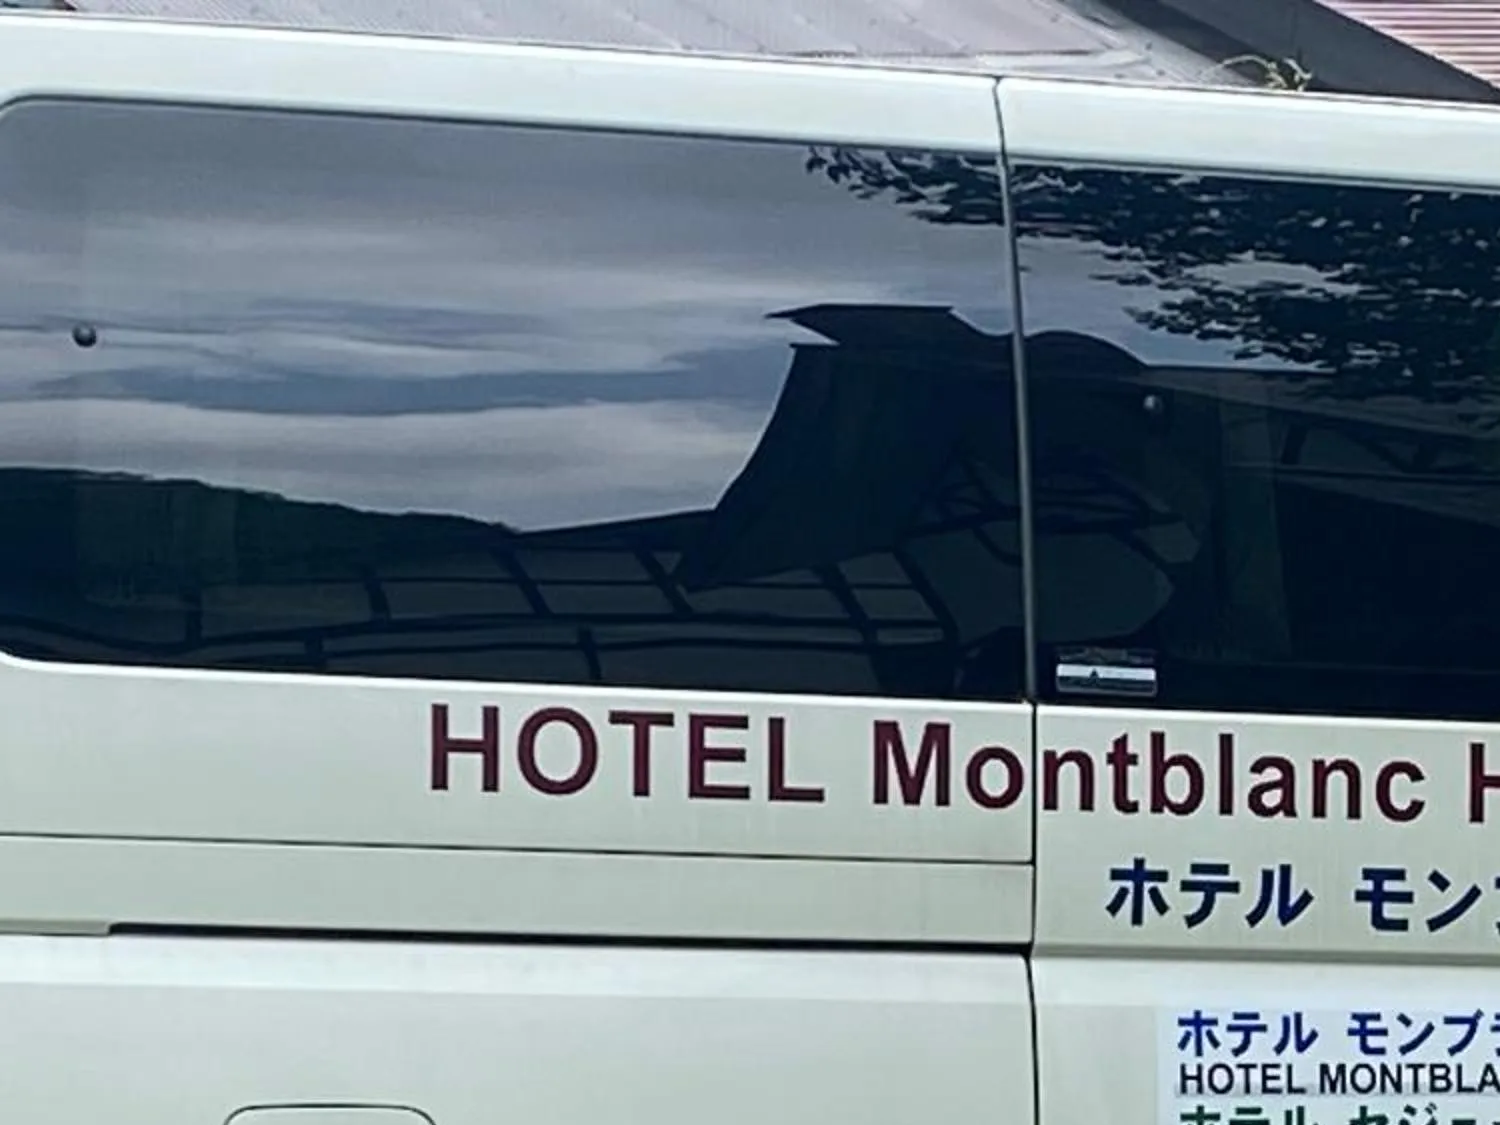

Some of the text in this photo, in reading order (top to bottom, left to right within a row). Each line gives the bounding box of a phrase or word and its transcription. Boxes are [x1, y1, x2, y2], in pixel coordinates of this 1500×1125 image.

[429, 704, 825, 804] HOTEL
[872, 718, 1429, 825] Montblanc
[1106, 857, 1314, 930] ホテル
[1177, 1010, 1319, 1057] ホテル
[1179, 1063, 1307, 1095] HOTEL
